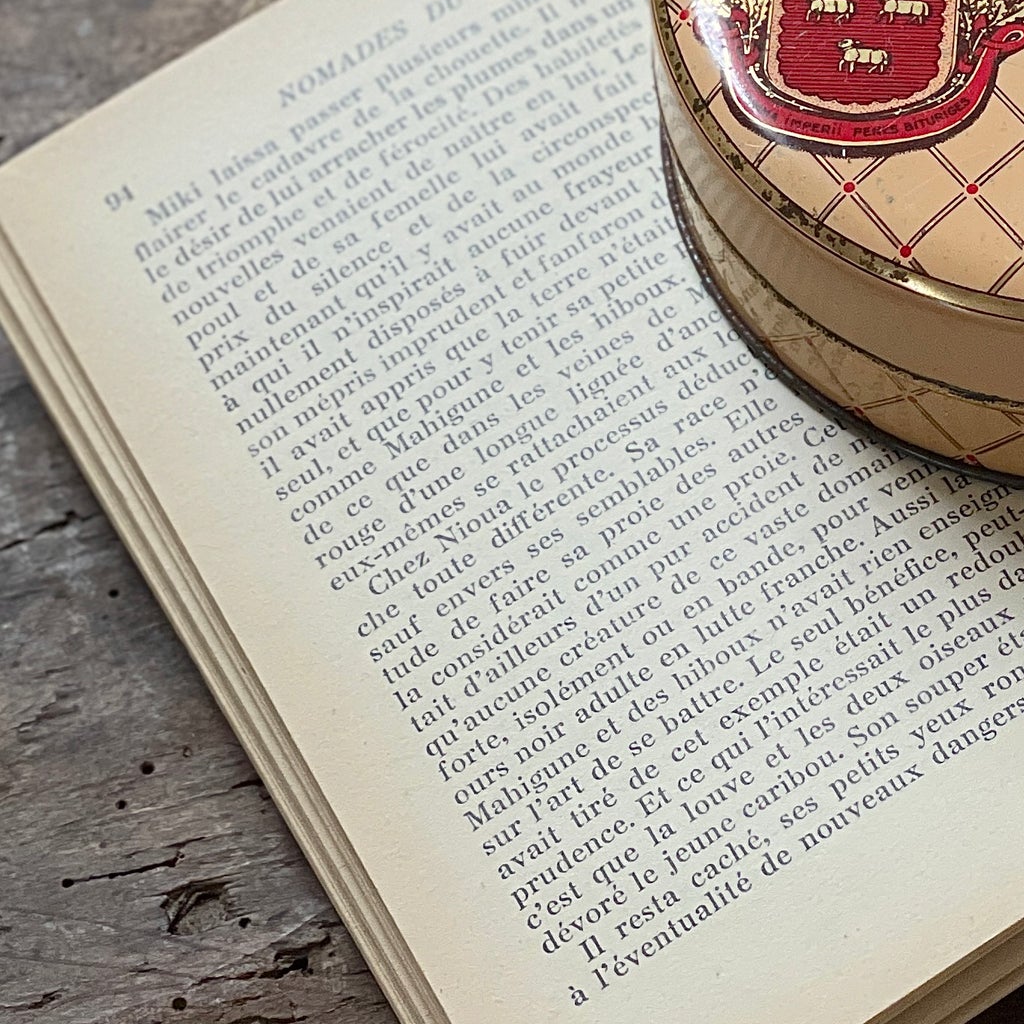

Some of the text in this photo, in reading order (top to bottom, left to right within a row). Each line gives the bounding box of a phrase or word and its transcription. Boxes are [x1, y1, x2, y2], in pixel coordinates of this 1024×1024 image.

[143, 180, 203, 227] Miki
[208, 139, 281, 187] laissa
[287, 86, 363, 145] passer
[373, 21, 483, 94] plusieurs
[277, 19, 409, 108] NOMADES
[104, 184, 135, 213] 94
[209, 129, 635, 392] maintenant qu'il y avait au monde
[221, 144, 654, 412] à qui il n'inspirait aucune frayeur
[290, 274, 686, 523] comme Mahigune et les hiboux.
[330, 345, 709, 591] eux-mêmes se rattachaient aux
[357, 396, 728, 638] che toute différente. Sa race
[392, 451, 797, 712] la considérait comme une proie.
[438, 496, 870, 782] forte, isolément ou en bande, pour
[482, 548, 958, 857] sur l'art de se battre. Le seul bénéfice,
[527, 881, 583, 930] c'est
[592, 847, 639, 888] que
[643, 823, 677, 847] la
[679, 770, 755, 823] louve
[765, 742, 791, 768] et
[793, 716, 836, 748] les
[843, 670, 911, 716] deux
[918, 607, 1018, 670] oiseaux
[567, 985, 589, 1007] à
[591, 870, 753, 990] l'éventualité
[760, 849, 793, 876] de
[797, 763, 925, 852] nouveaux
[577, 934, 607, 963] Il
[613, 890, 681, 940] resta
[691, 828, 771, 888] caché,
[779, 794, 819, 830] ses
[825, 743, 900, 802] petits
[908, 697, 974, 750] yeux
